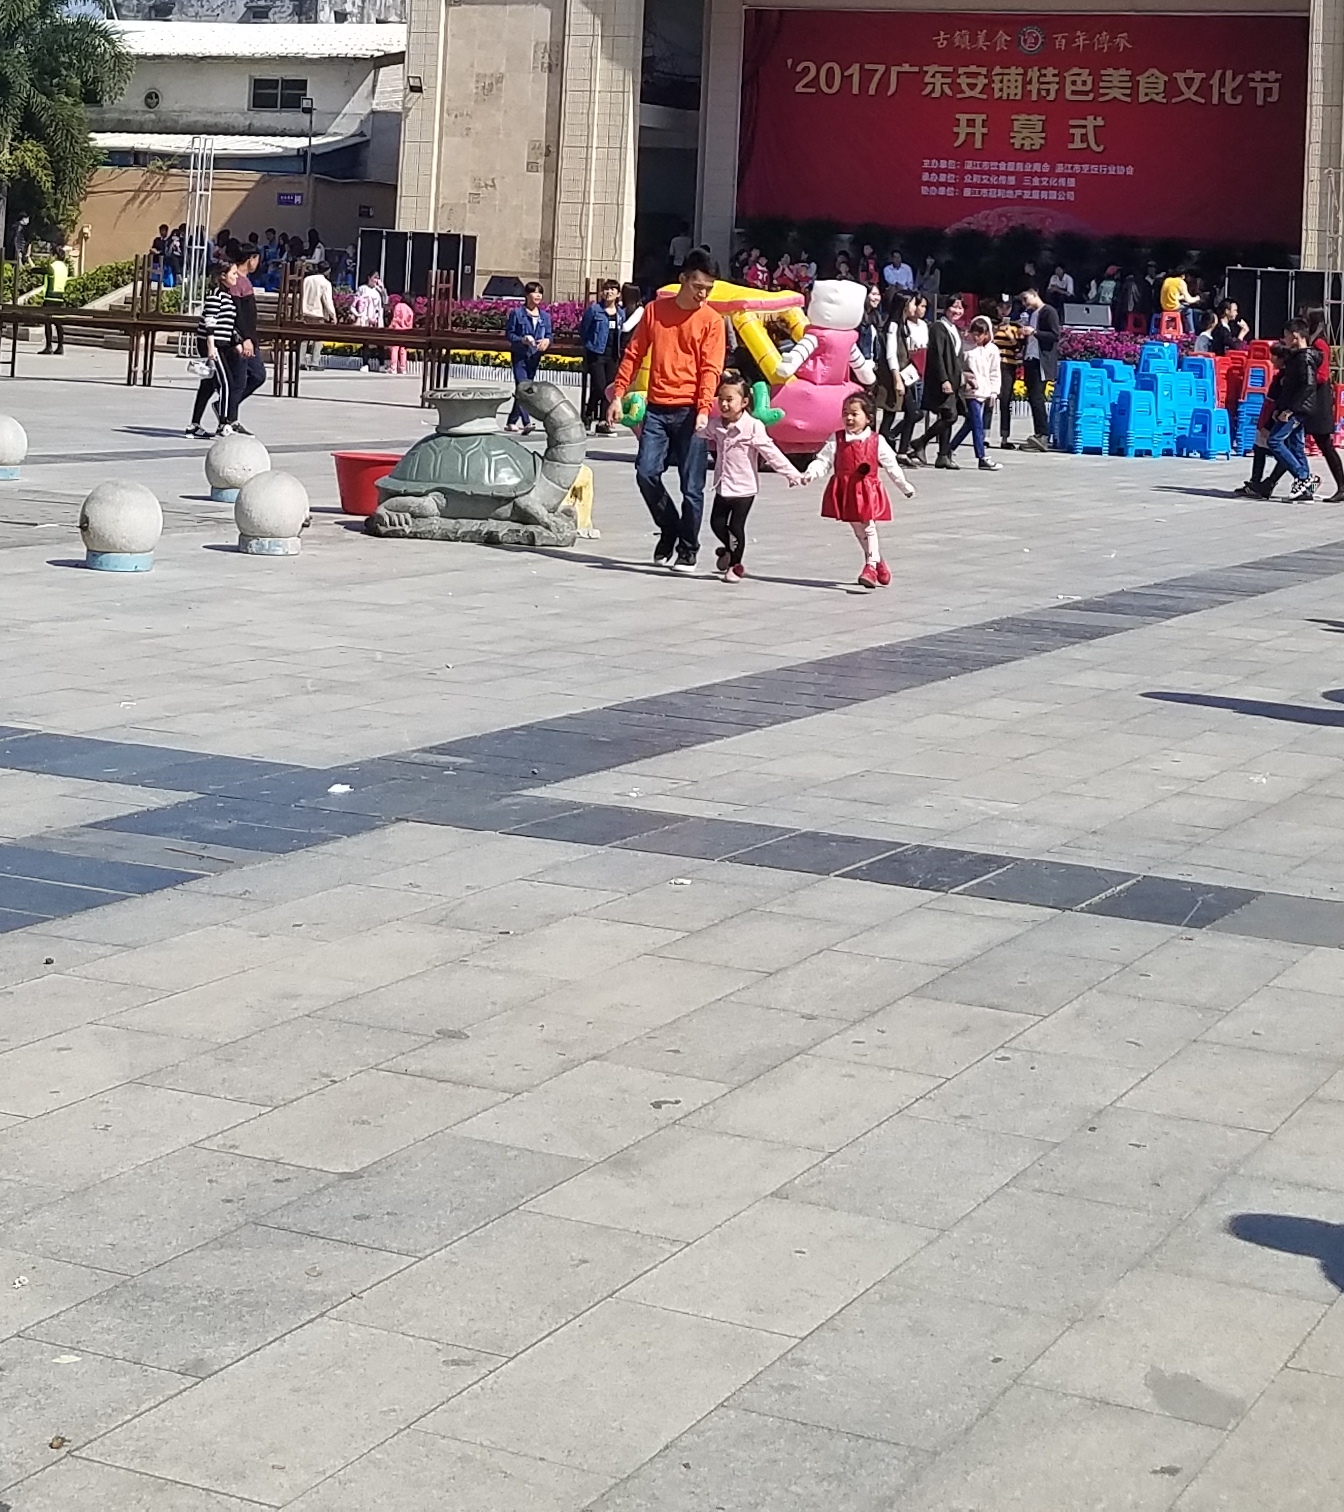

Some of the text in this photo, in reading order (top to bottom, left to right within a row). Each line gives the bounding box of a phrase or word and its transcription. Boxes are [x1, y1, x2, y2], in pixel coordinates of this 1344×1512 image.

[786, 58, 1282, 106] '2017广东安铺特色美食文化节
[953, 113, 1105, 152] 开幕式
